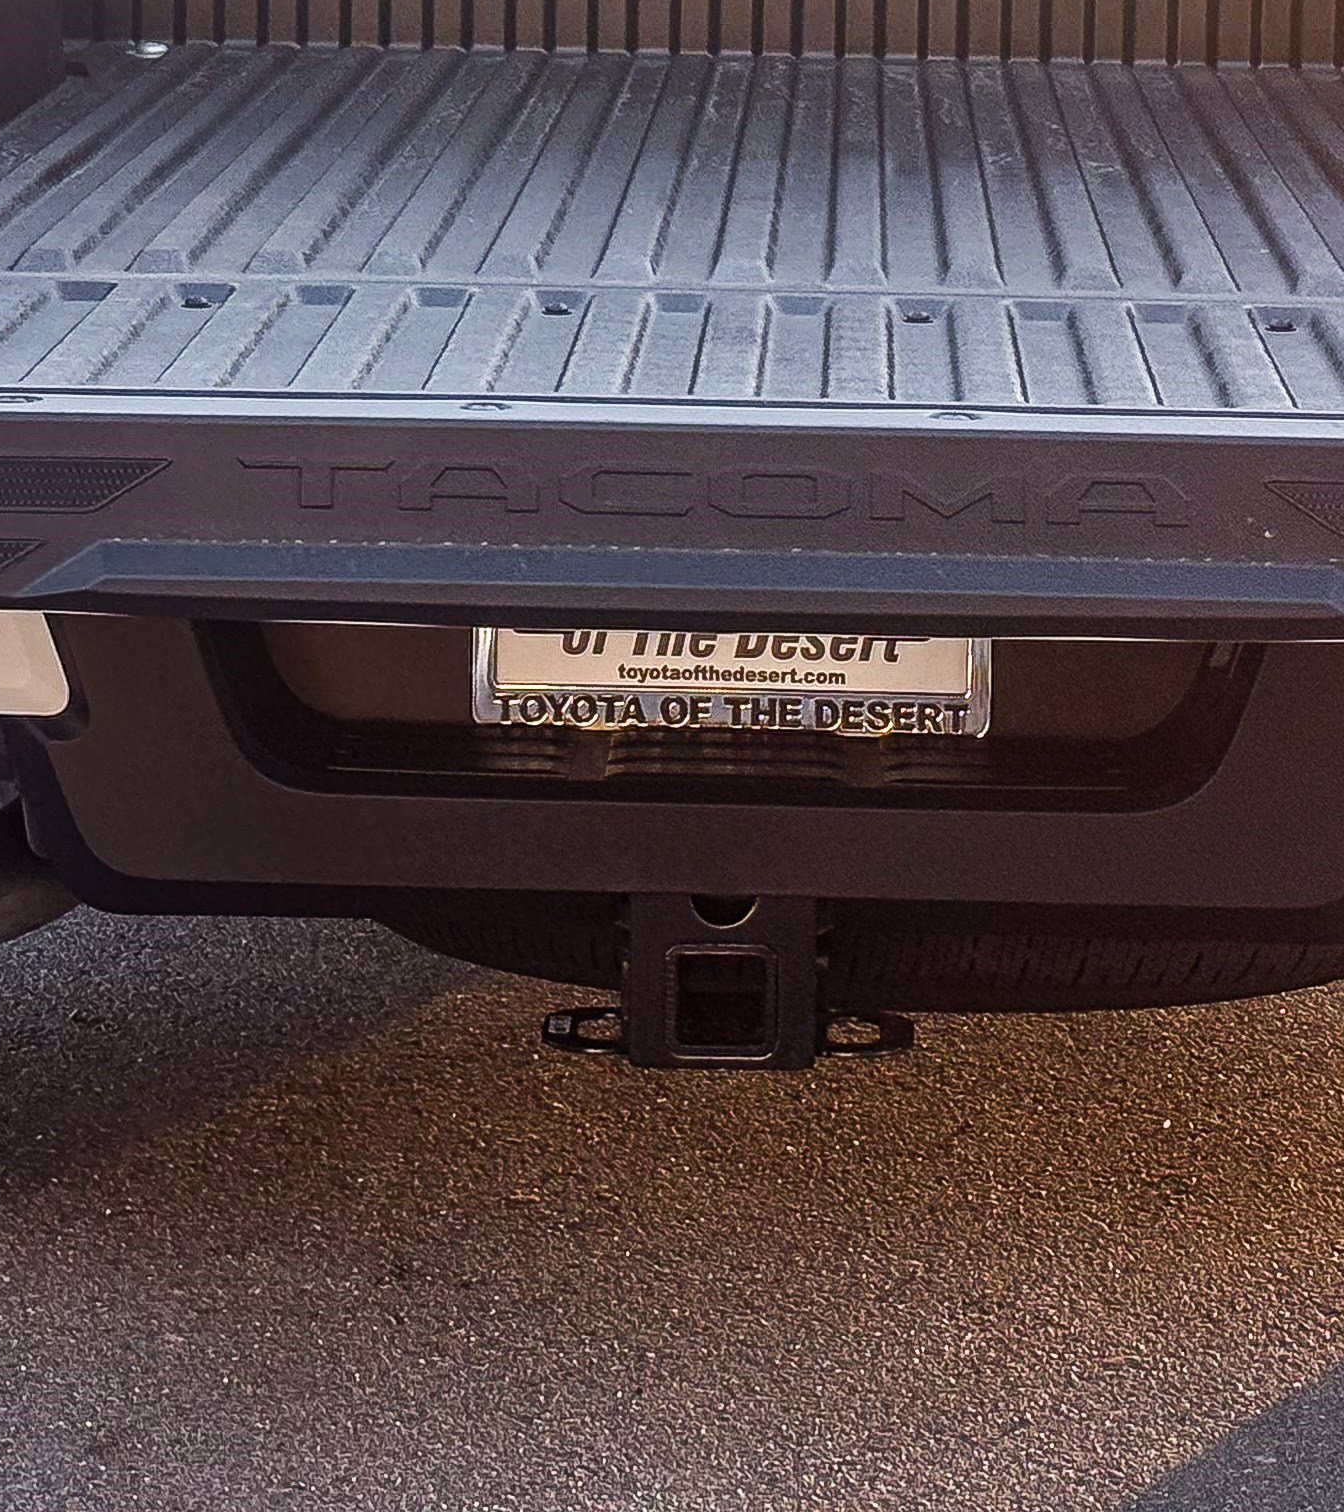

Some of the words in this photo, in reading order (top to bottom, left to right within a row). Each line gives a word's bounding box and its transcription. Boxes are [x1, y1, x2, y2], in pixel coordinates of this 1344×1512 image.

[236, 456, 1190, 528] TACOMA
[618, 663, 846, 685] toyotaofthedesert.com
[493, 692, 648, 727] TOYOTA
[659, 694, 713, 729] OF
[723, 696, 803, 729] THE
[813, 697, 971, 735] DESERT
